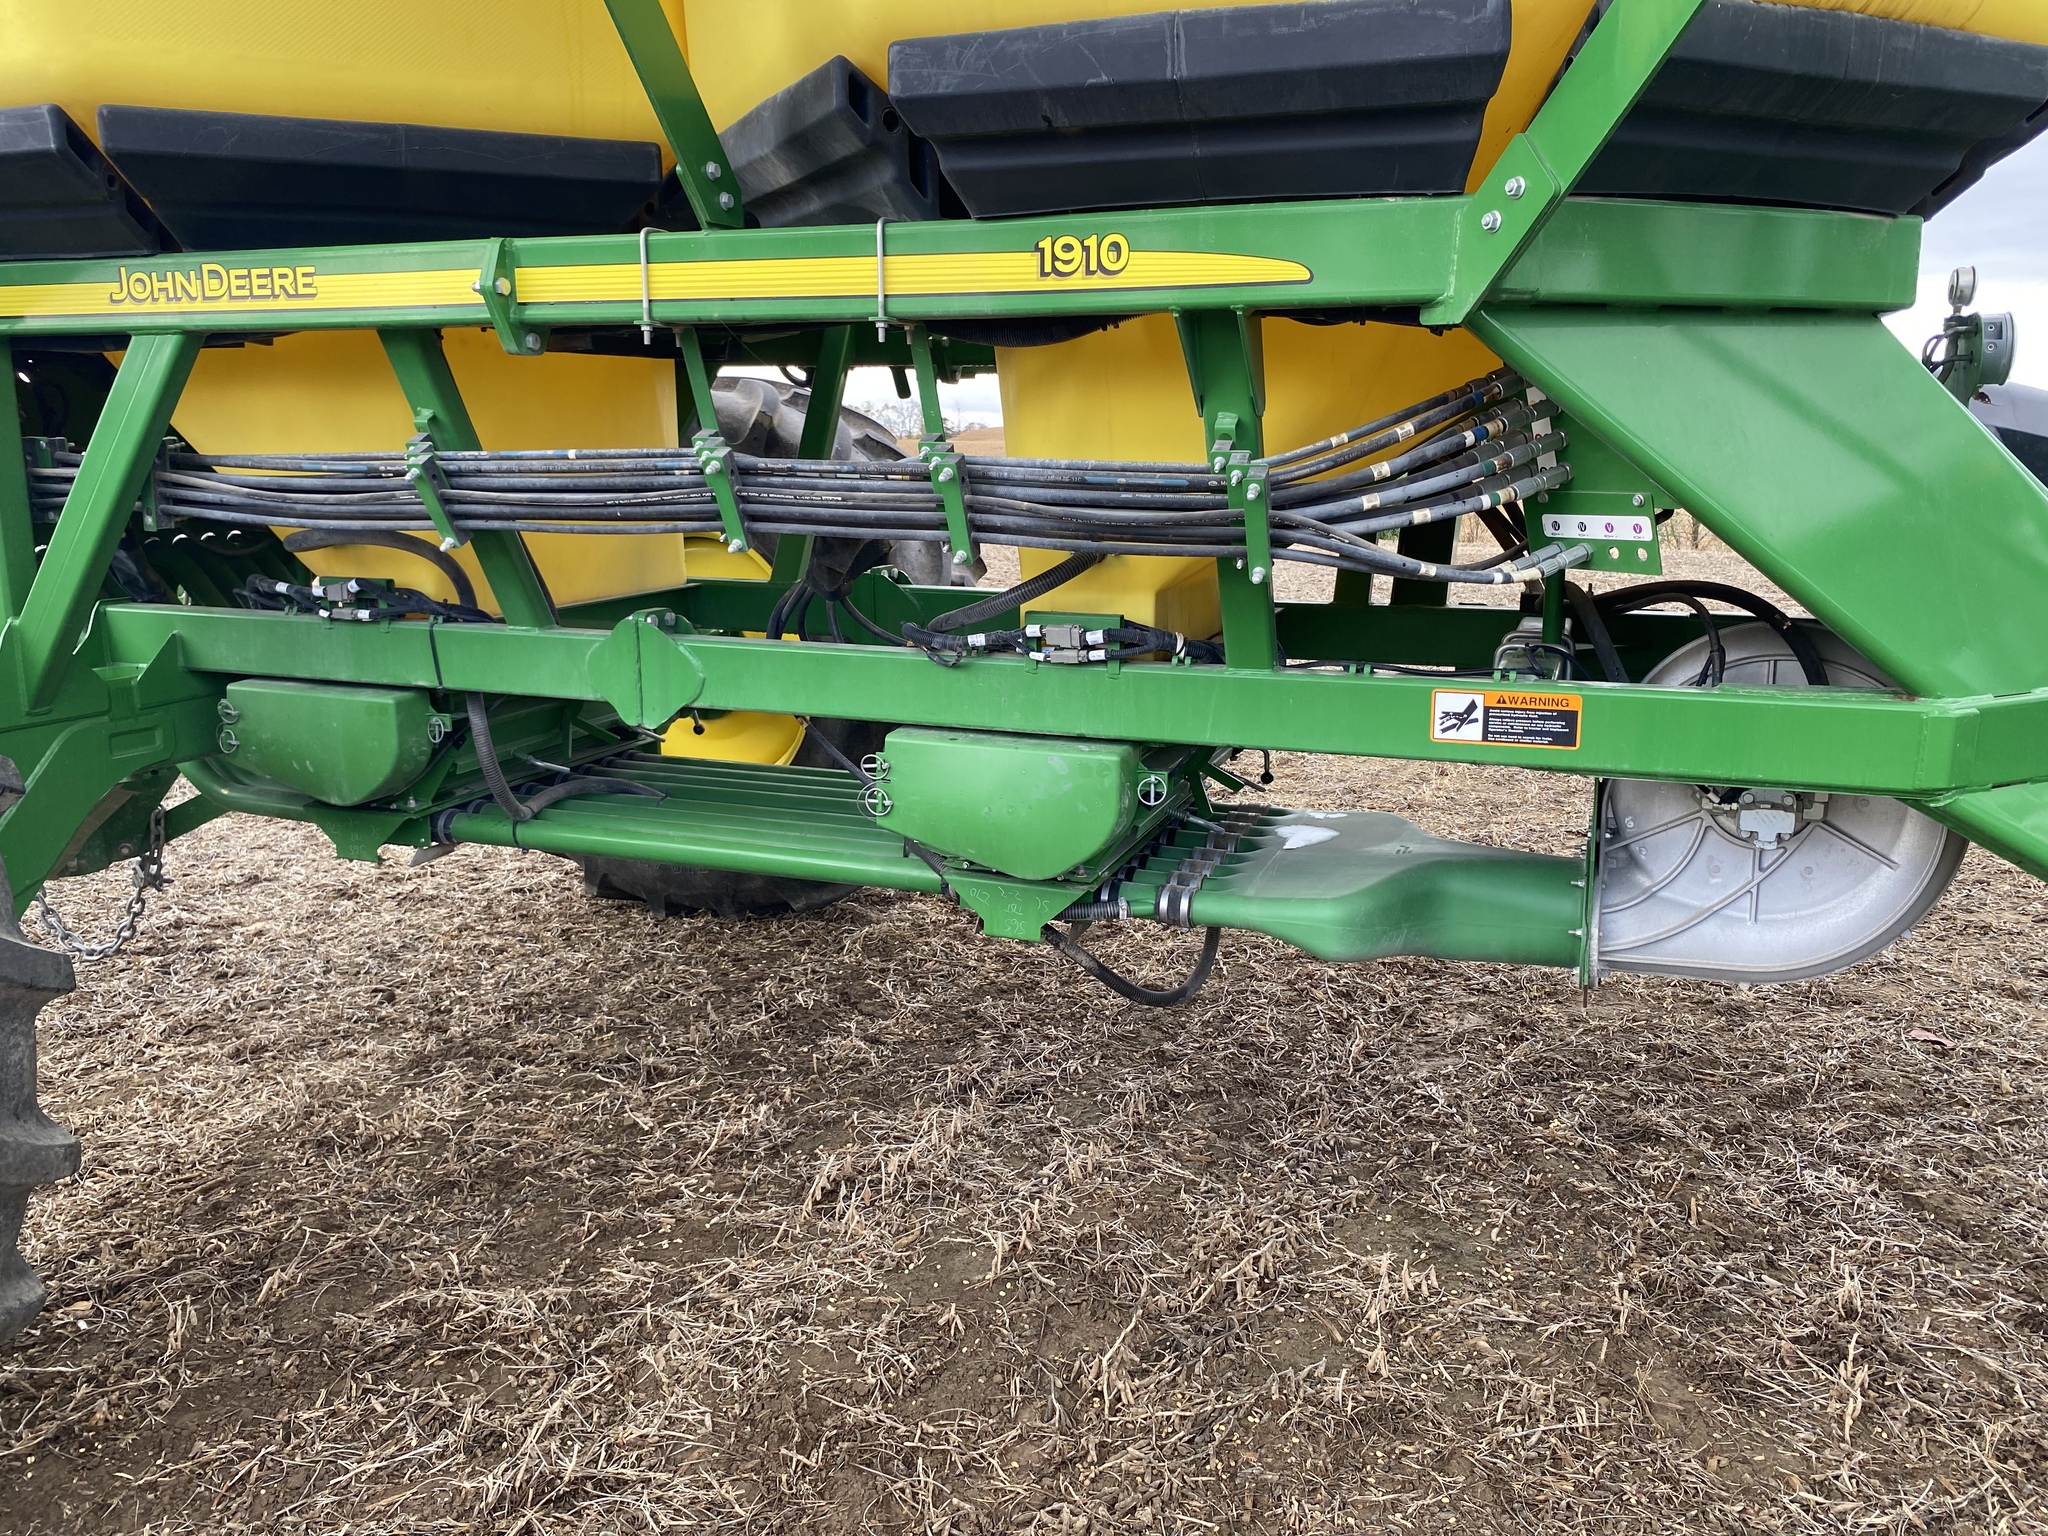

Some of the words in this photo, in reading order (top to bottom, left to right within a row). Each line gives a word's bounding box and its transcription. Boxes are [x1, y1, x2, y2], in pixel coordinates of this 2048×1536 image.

[1034, 232, 1130, 278] 1910
[110, 265, 198, 303] JOHN
[201, 263, 317, 301] DEERE
[1508, 695, 1570, 707] WARNING
